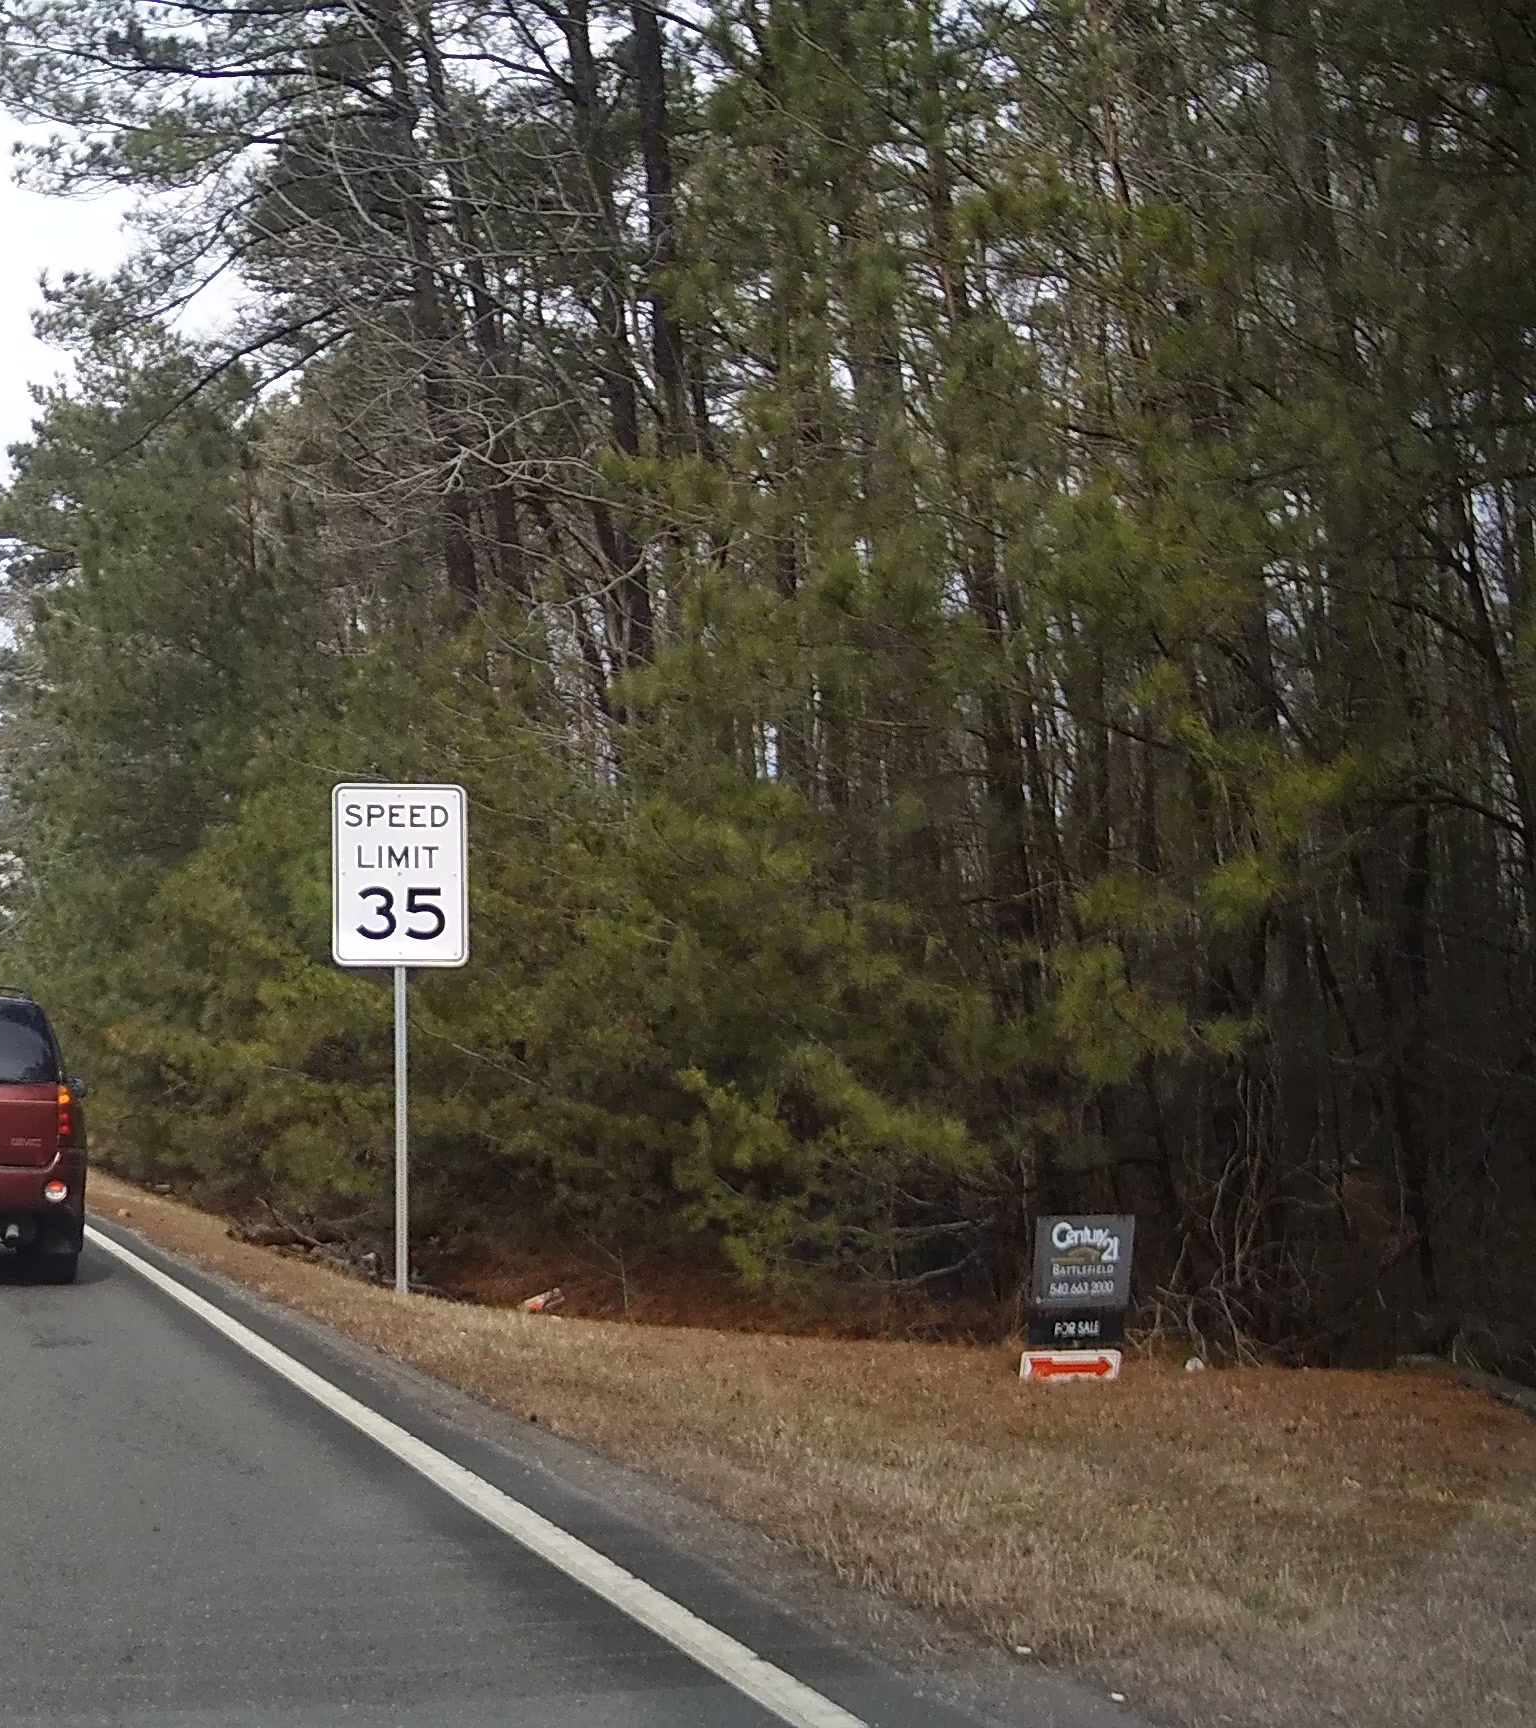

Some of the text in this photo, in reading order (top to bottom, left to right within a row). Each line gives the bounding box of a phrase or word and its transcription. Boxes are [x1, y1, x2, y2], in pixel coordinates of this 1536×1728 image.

[345, 804, 449, 828] SPEED
[357, 845, 439, 869] LIMIT
[355, 885, 446, 940] 35
[1052, 1222, 1110, 1249] Century
[1101, 1236, 1119, 1261] 21
[1054, 1320, 1100, 1336] FOR SALE
